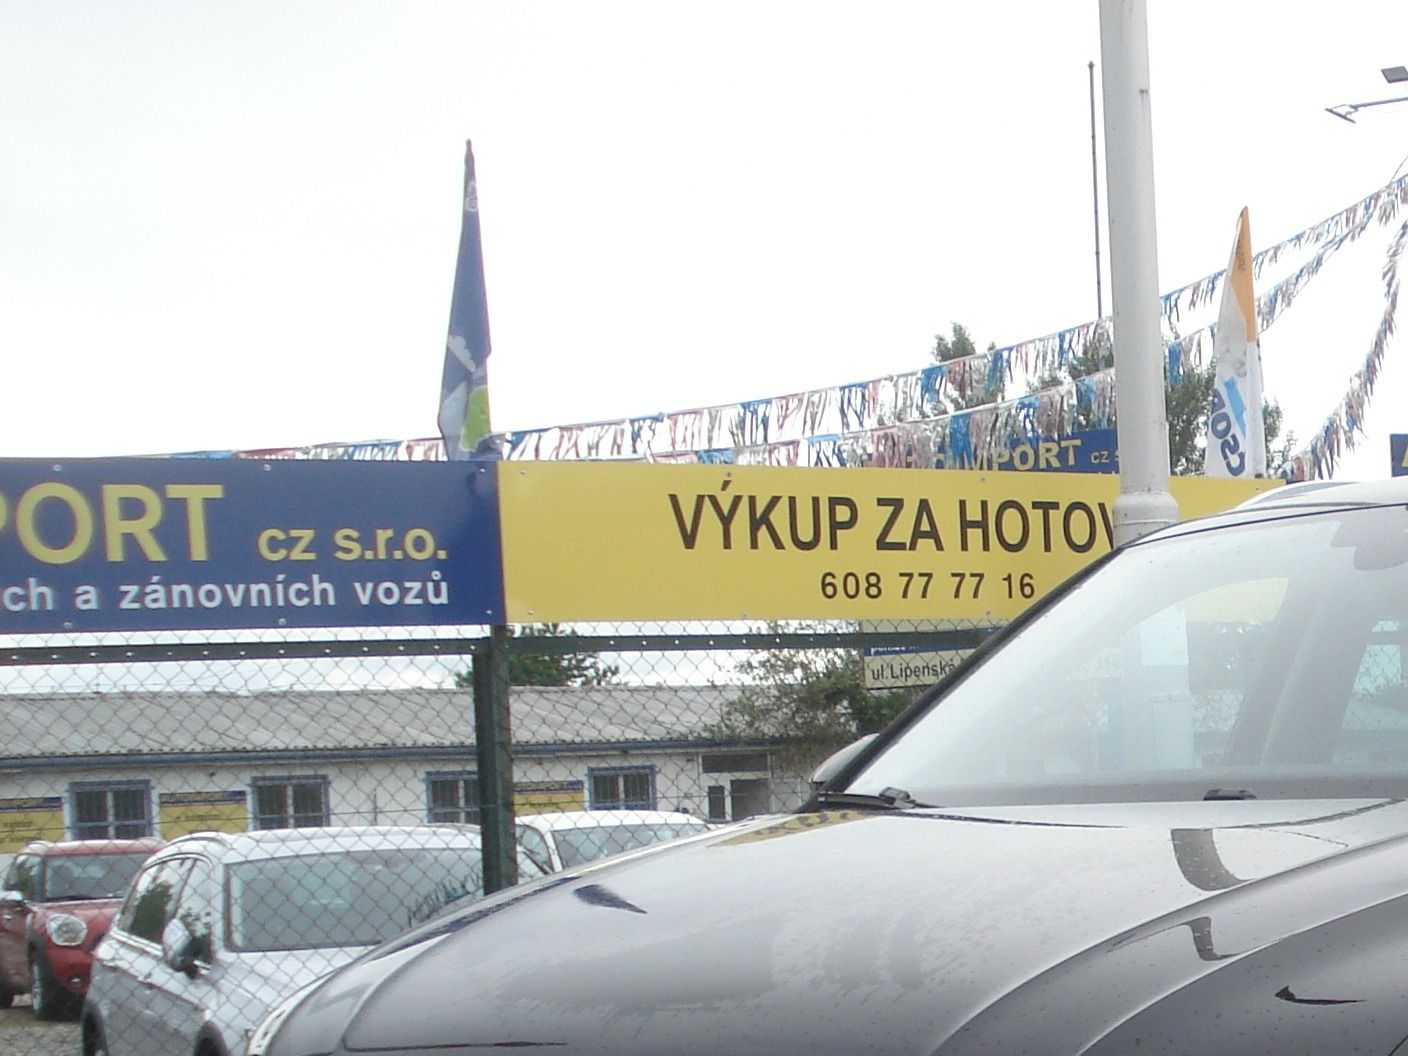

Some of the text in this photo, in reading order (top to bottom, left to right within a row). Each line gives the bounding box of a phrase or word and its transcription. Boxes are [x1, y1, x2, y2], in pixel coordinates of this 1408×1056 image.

[668, 479, 858, 551] VÝKUP
[876, 498, 941, 552] ZA
[258, 528, 316, 561] cz
[334, 527, 447, 561] s.r.o.
[75, 584, 98, 611] a
[120, 574, 336, 611] zánovních
[354, 571, 449, 606] vozů
[821, 571, 1036, 600] 608 77 77 16
